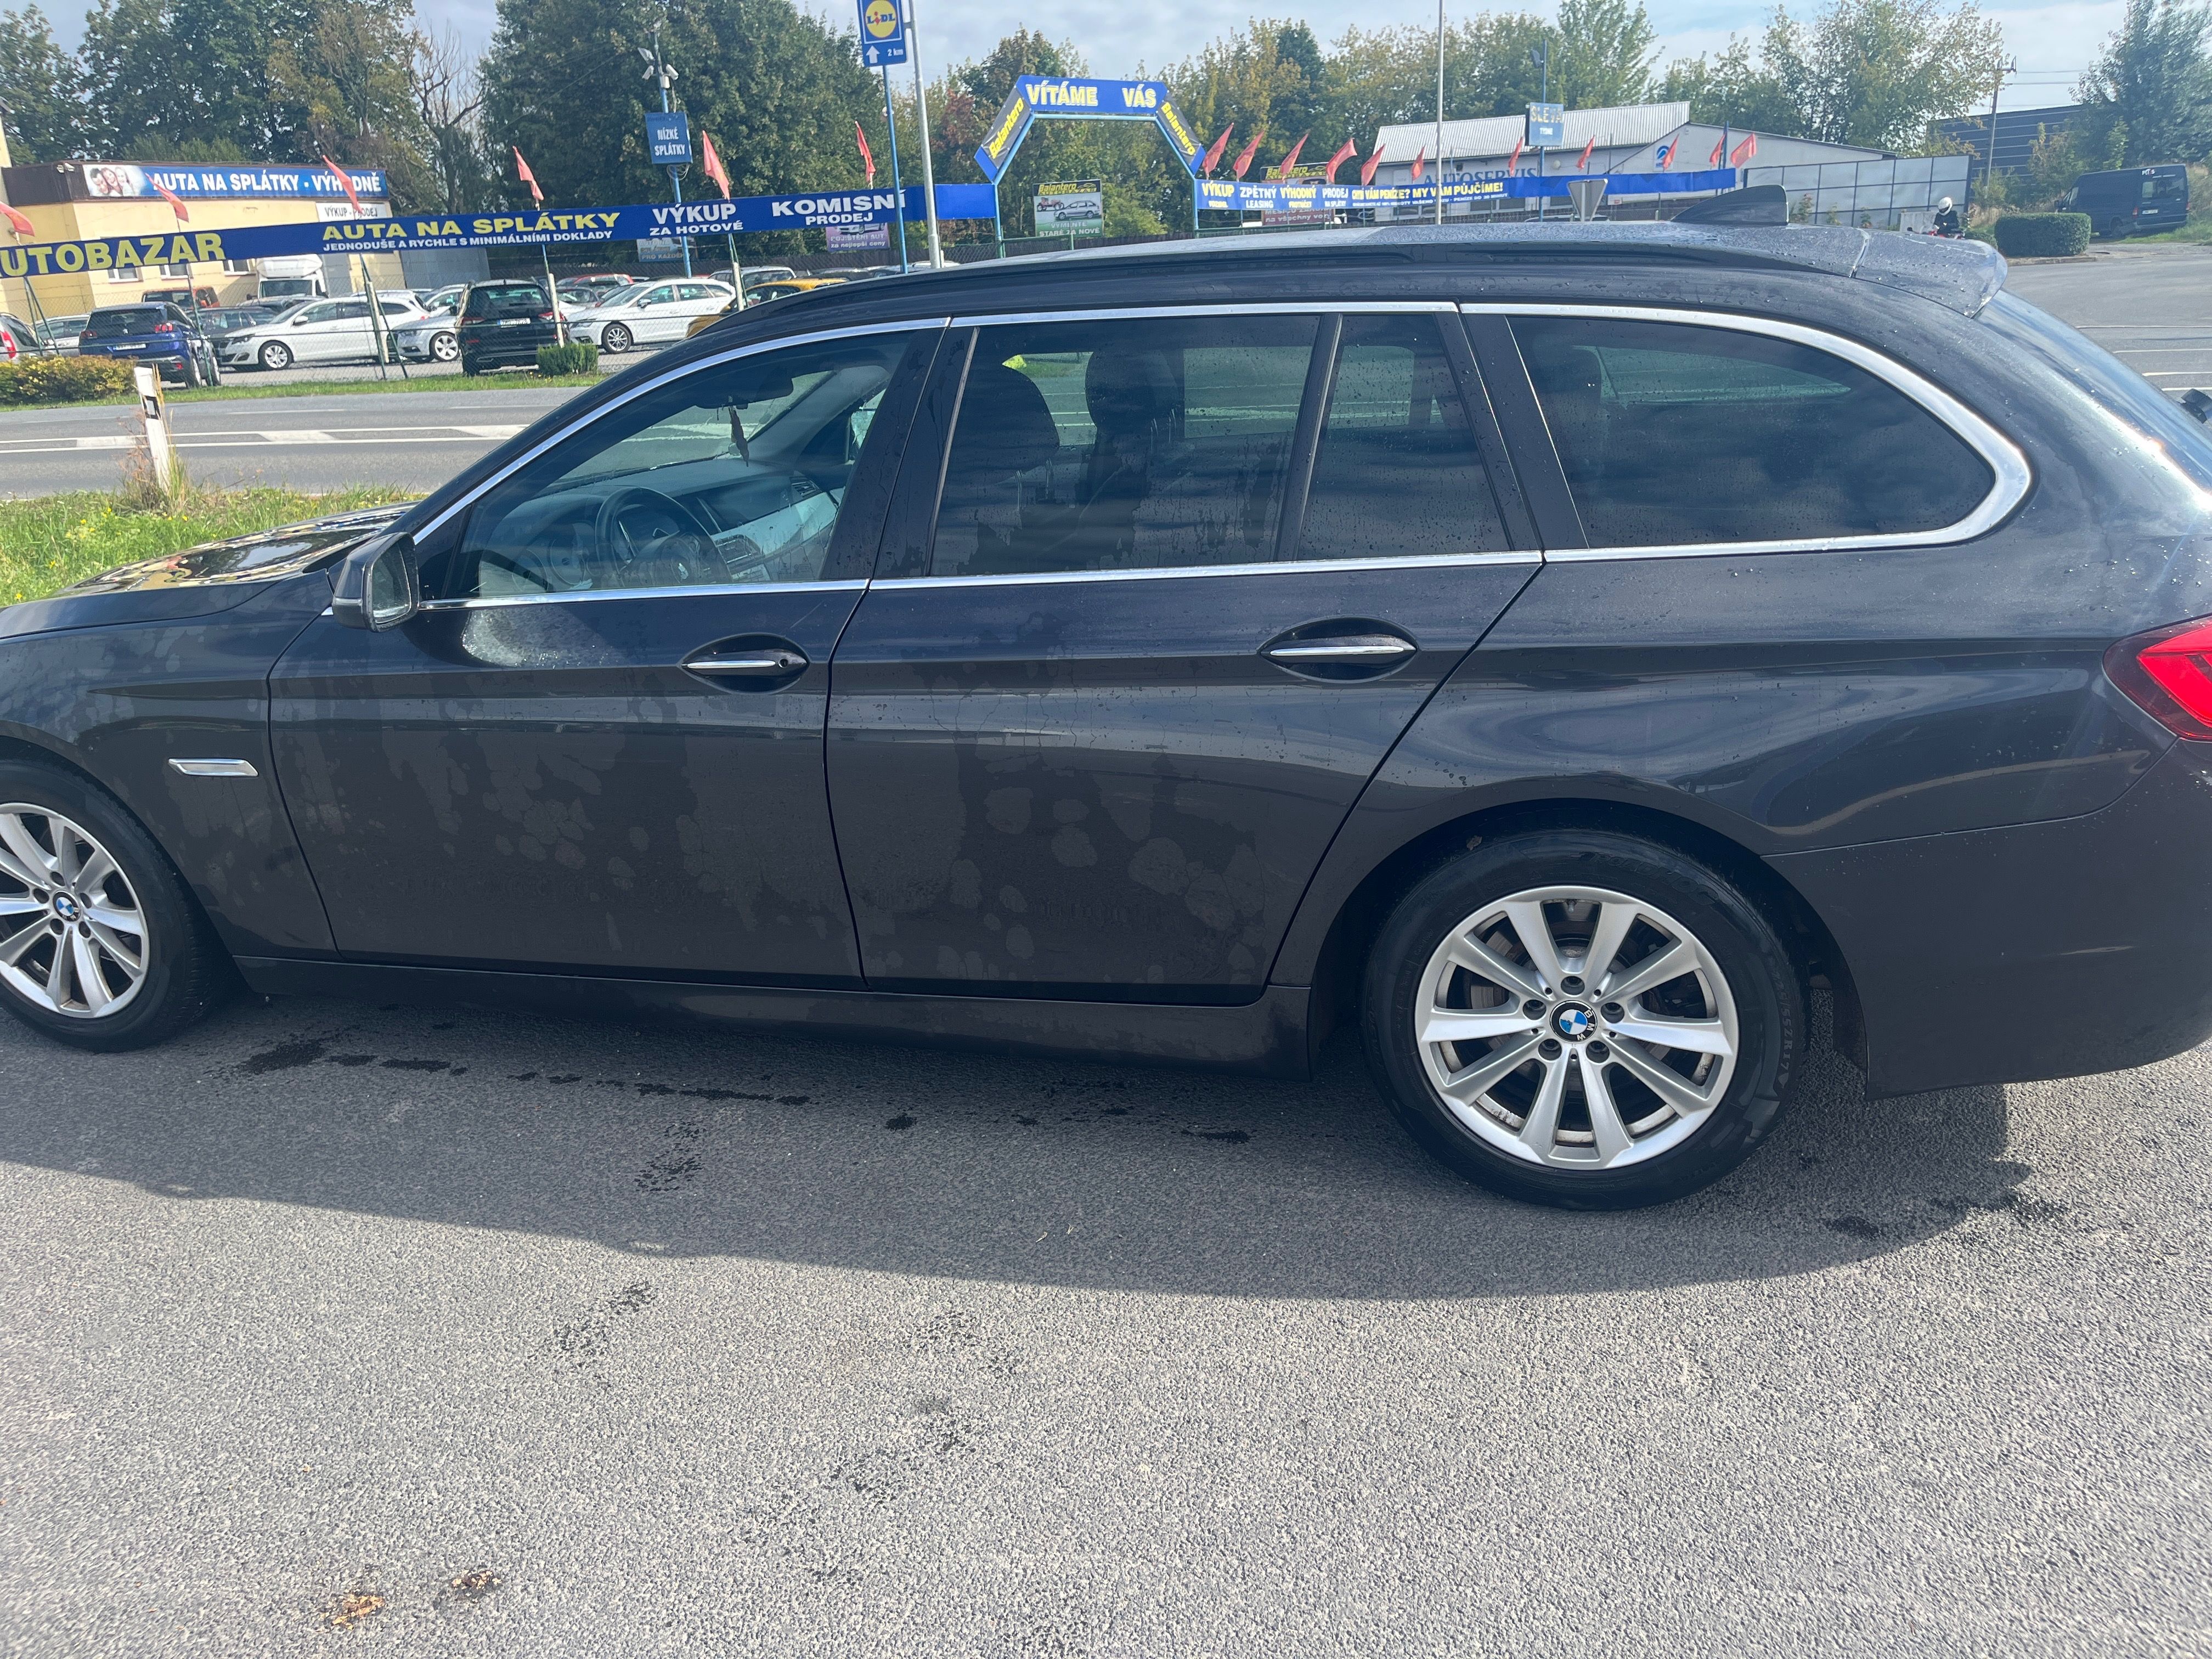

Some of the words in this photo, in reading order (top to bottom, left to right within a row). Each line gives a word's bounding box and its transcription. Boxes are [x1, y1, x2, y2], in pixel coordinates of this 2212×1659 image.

[1025, 80, 1098, 106] VÍTÁME
[1122, 84, 1157, 108] VÁS
[657, 126, 679, 140] NÍZKÉ
[989, 98, 1025, 159] Balantero
[1161, 101, 1197, 156] Balantero
[654, 142, 685, 156] SPLÁTKY
[154, 173, 199, 190] AUTA
[202, 174, 228, 190] NA
[231, 169, 299, 191] SPLÁTKY
[311, 171, 382, 192] VÝHDNĚ
[1266, 166, 1308, 178] Baltero
[1201, 180, 1235, 197] VÝKUP
[1240, 185, 1277, 199] ZPĚTNÝ
[1280, 185, 1317, 199] VÝHODNÝ
[1322, 188, 1348, 199] PRODEJ
[1365, 187, 1379, 200] VÁM
[1380, 187, 1410, 199] PENÍZE?
[1413, 188, 1429, 198] MY
[1454, 182, 1503, 195] PŮJČÍME!
[324, 205, 347, 217] VÝKUP
[652, 203, 736, 225] VÝKUP
[771, 189, 906, 217] KOMISNÍ
[1246, 200, 1274, 208] LEASING
[323, 223, 408, 241] AUTA
[416, 221, 462, 236] NA
[473, 212, 620, 234] SPLÁTKY
[650, 227, 672, 236] ZA
[676, 220, 743, 235] HOTOVÉ
[805, 212, 873, 226] PRODEJ
[323, 238, 396, 252] JEDNODUŠE
[398, 240, 408, 248] A
[409, 238, 454, 248] RYCHLE
[459, 238, 467, 246] S
[470, 231, 550, 246] MINIMÁLNÍMI
[554, 230, 612, 242] DOKLADY
[1079, 227, 1101, 235] NOVÉ
[0, 232, 226, 276] UTOBAZAR
[1576, 1009, 1595, 1040] BMW
